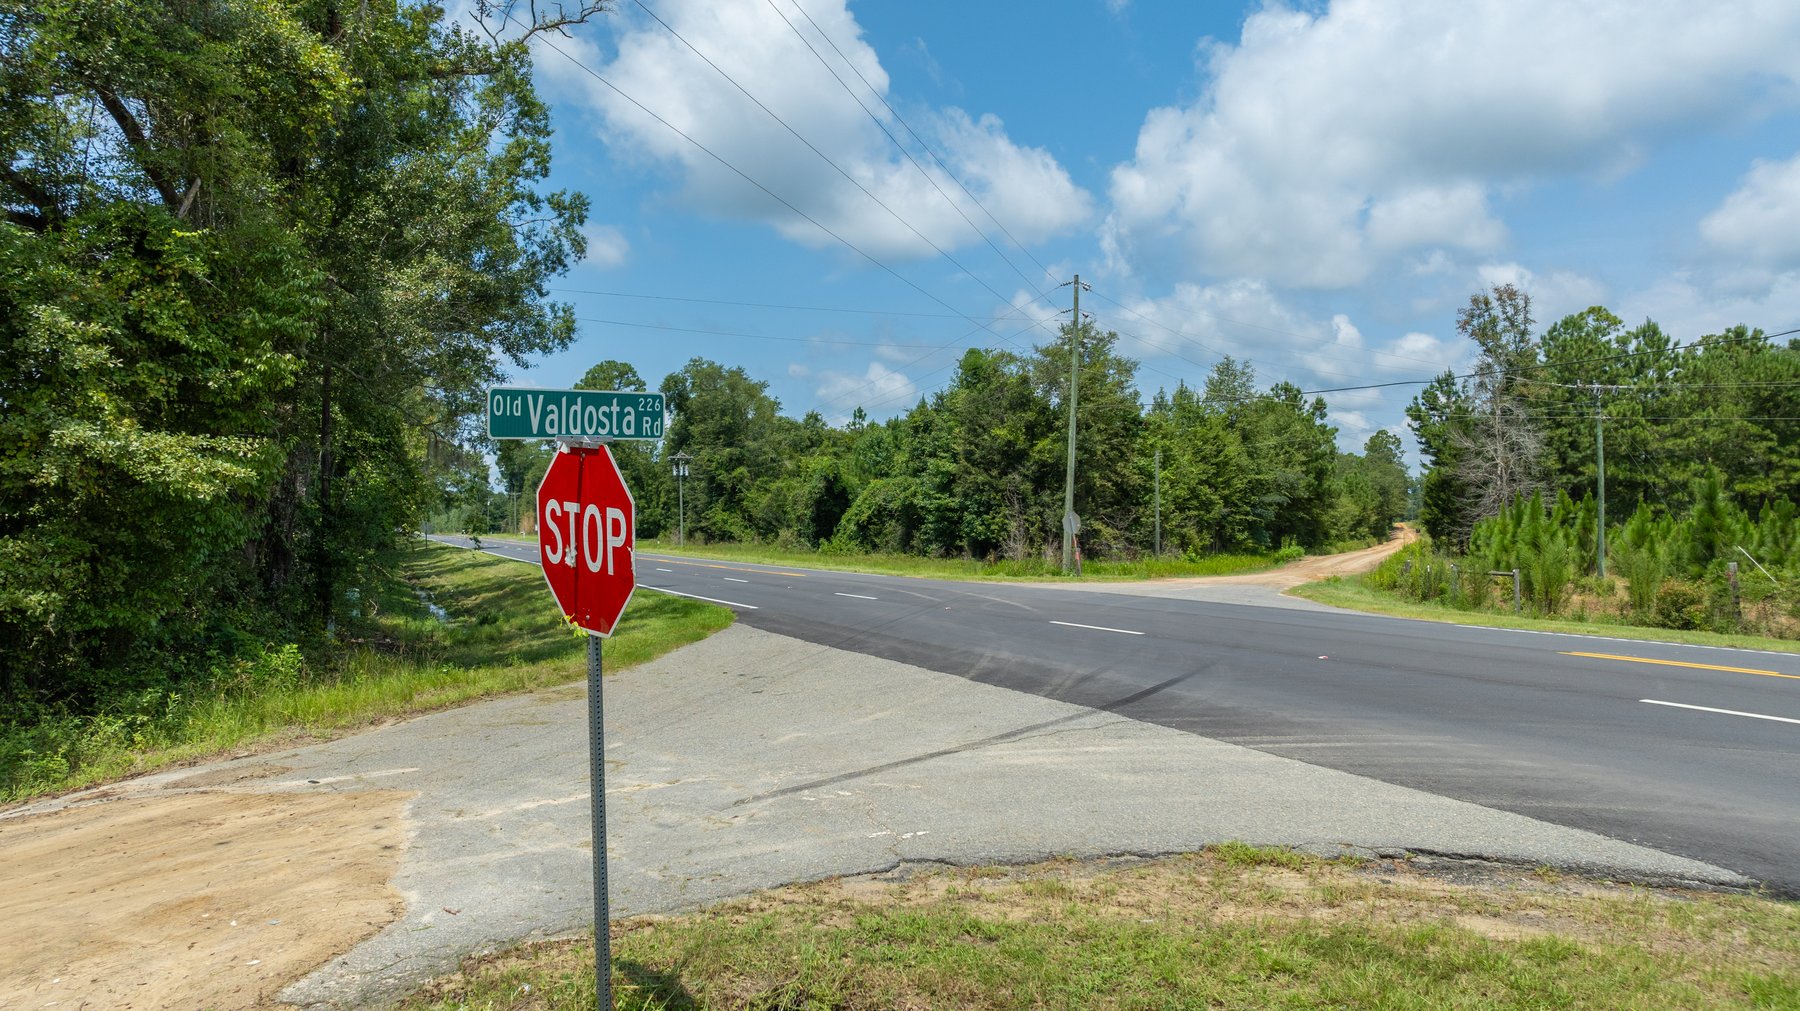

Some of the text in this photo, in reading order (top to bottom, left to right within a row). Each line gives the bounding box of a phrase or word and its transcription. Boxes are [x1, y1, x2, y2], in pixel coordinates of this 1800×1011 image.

[493, 394, 661, 436] Old Valdosta Rd
[638, 398, 661, 411] 226
[545, 499, 627, 576] STOP
